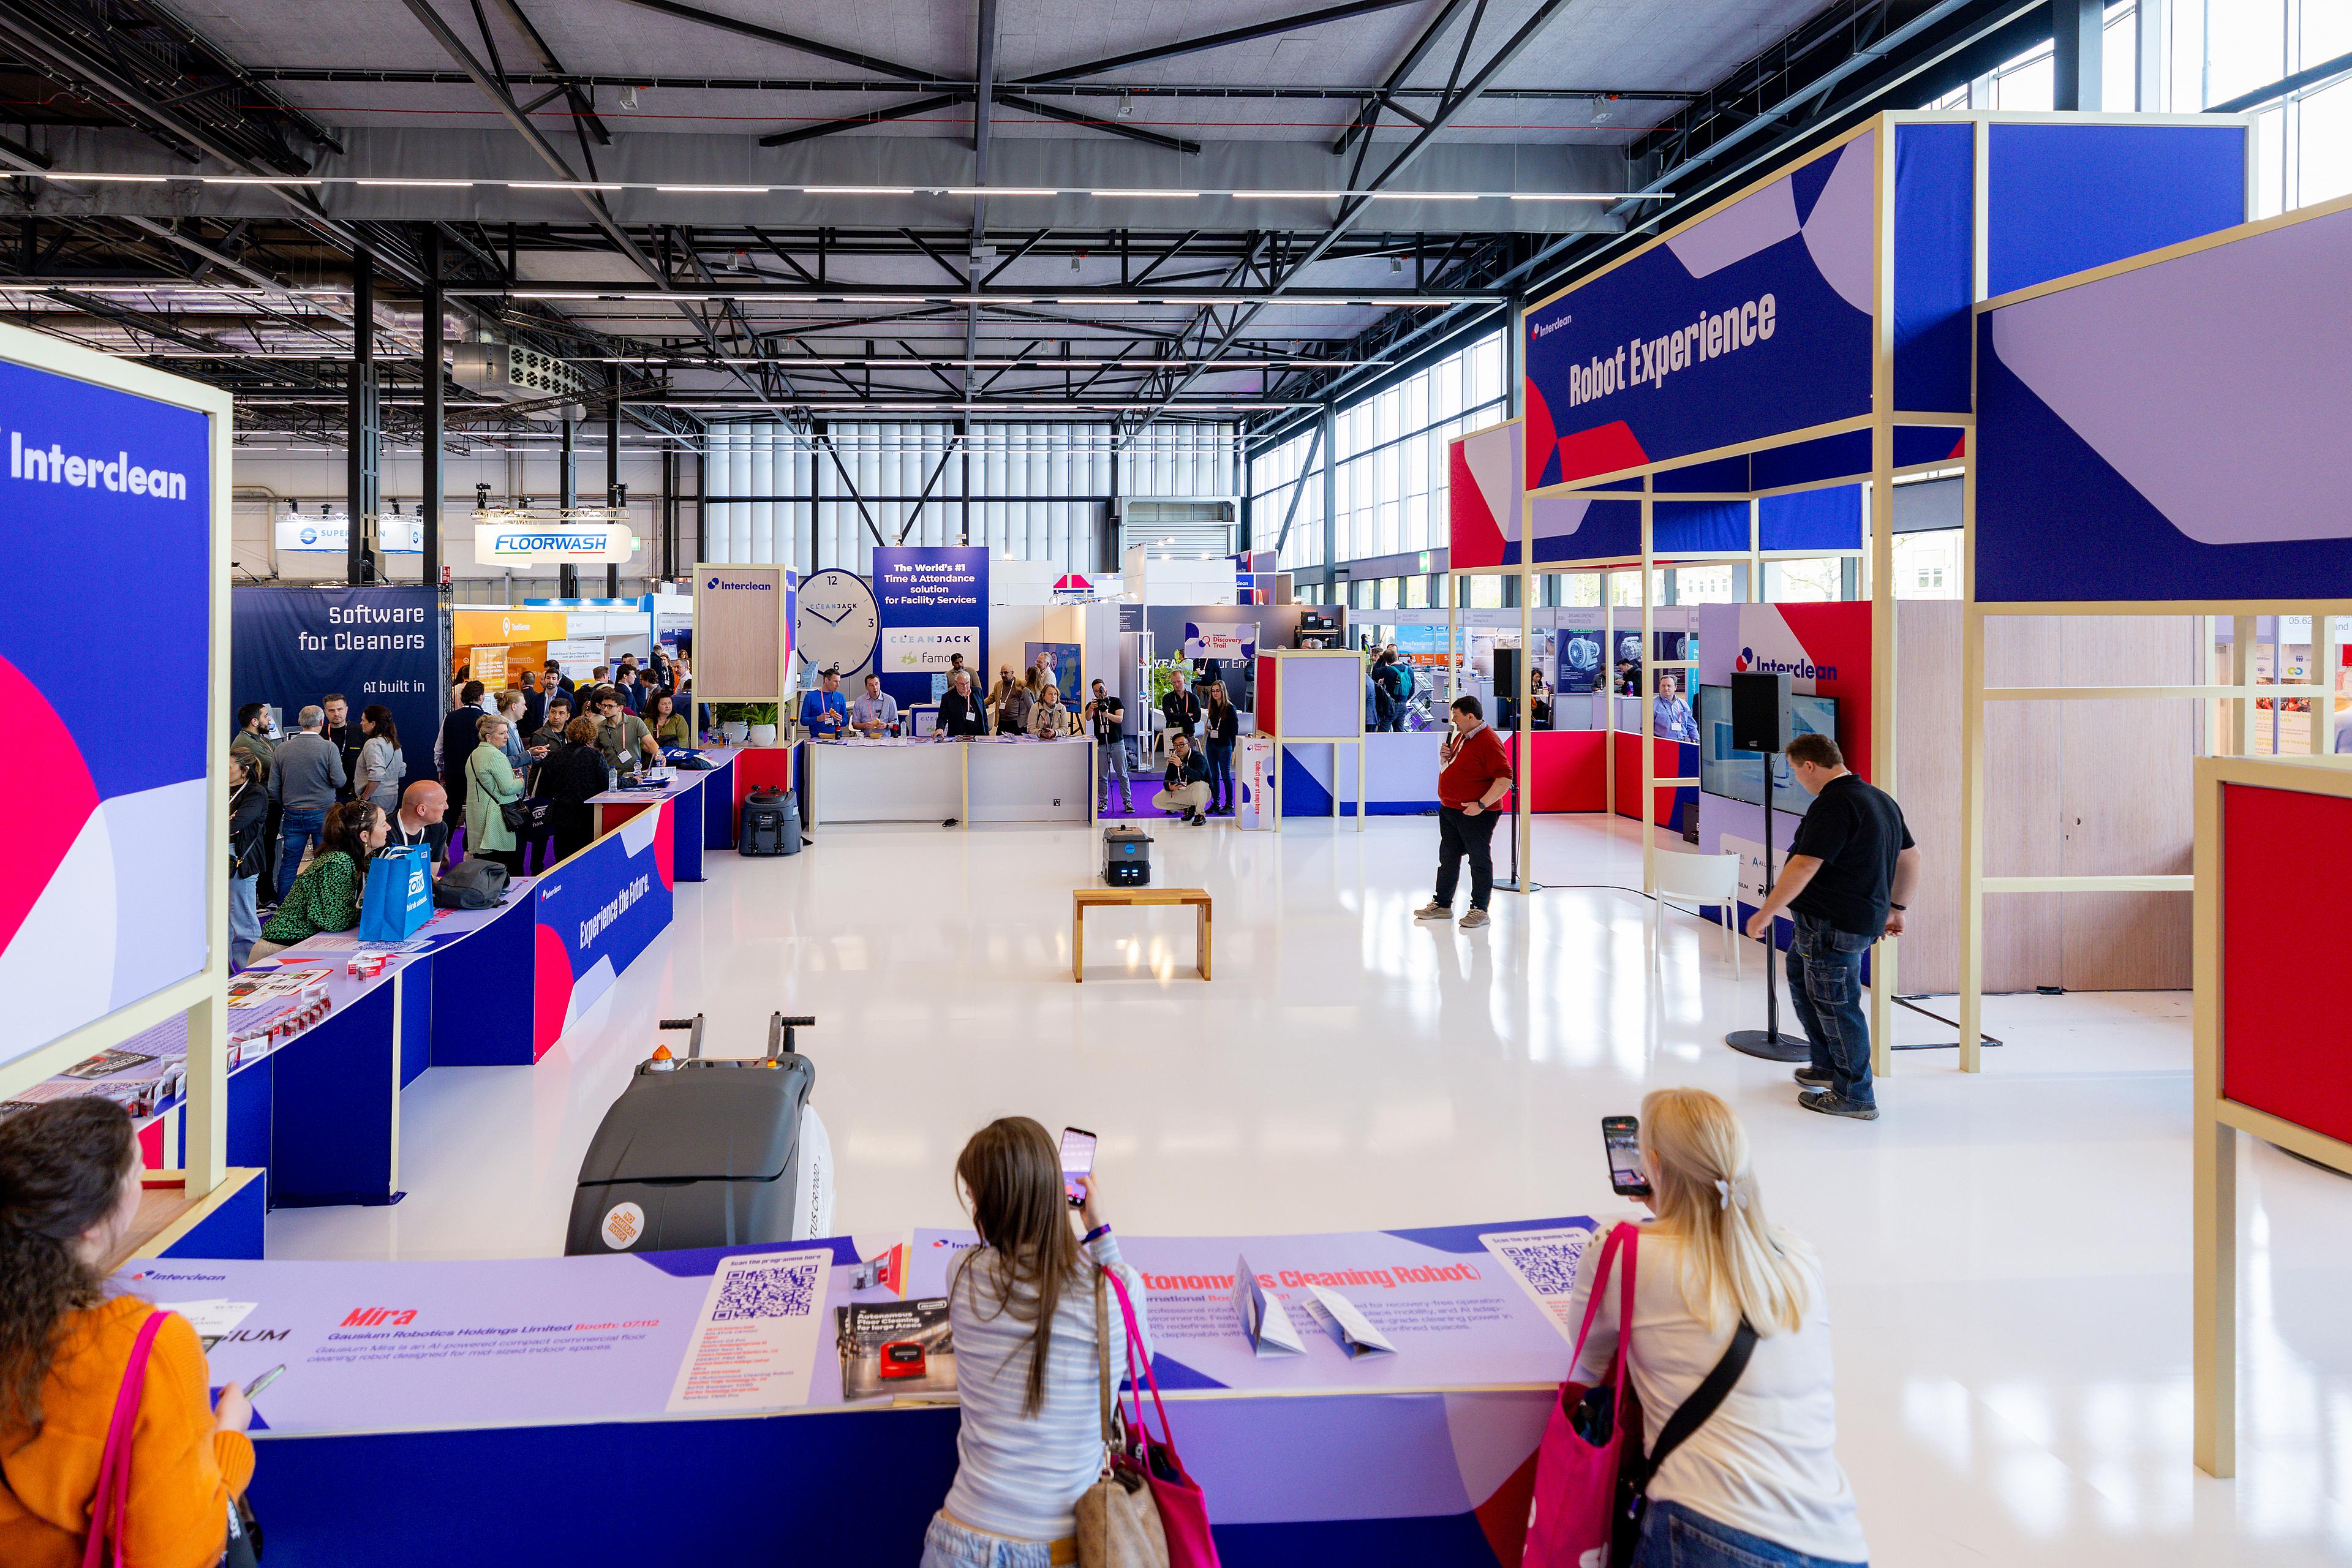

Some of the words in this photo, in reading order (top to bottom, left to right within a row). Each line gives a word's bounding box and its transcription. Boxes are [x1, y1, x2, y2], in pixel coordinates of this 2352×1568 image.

[1540, 314, 1572, 337] Interclean
[1570, 345, 1625, 407] Robot
[1630, 293, 1776, 388] Experience
[11, 431, 186, 500] Interclean
[495, 534, 607, 550] FLOORWASH
[722, 581, 771, 590] Interclean
[827, 576, 838, 586] 12
[901, 596, 935, 606] Facility
[937, 595, 977, 604] Services
[330, 605, 424, 624] Software
[868, 619, 874, 628] 3
[298, 631, 328, 650] for
[334, 631, 424, 650] Cleaners
[834, 662, 839, 671] 6
[363, 682, 376, 693] AI
[379, 680, 409, 693] built
[413, 680, 424, 692] in
[546, 884, 562, 900] Interclean
[407, 901, 417, 911] hink
[580, 898, 617, 949] Experience
[619, 889, 629, 914] the
[629, 873, 650, 907] Future.
[612, 1214, 635, 1237] CAMERAS
[625, 1213, 634, 1223] NO
[609, 1224, 627, 1241] INSIDE
[1279, 1268, 1396, 1289] Cleaning
[1392, 1263, 1482, 1284] Robot)
[339, 1307, 418, 1327] Mira
[458, 1327, 518, 1336] Holdings
[521, 1324, 573, 1333] Limited
[574, 1322, 618, 1331] Booth:
[553, 1335, 618, 1344] commercial
[393, 1351, 448, 1359] designed
